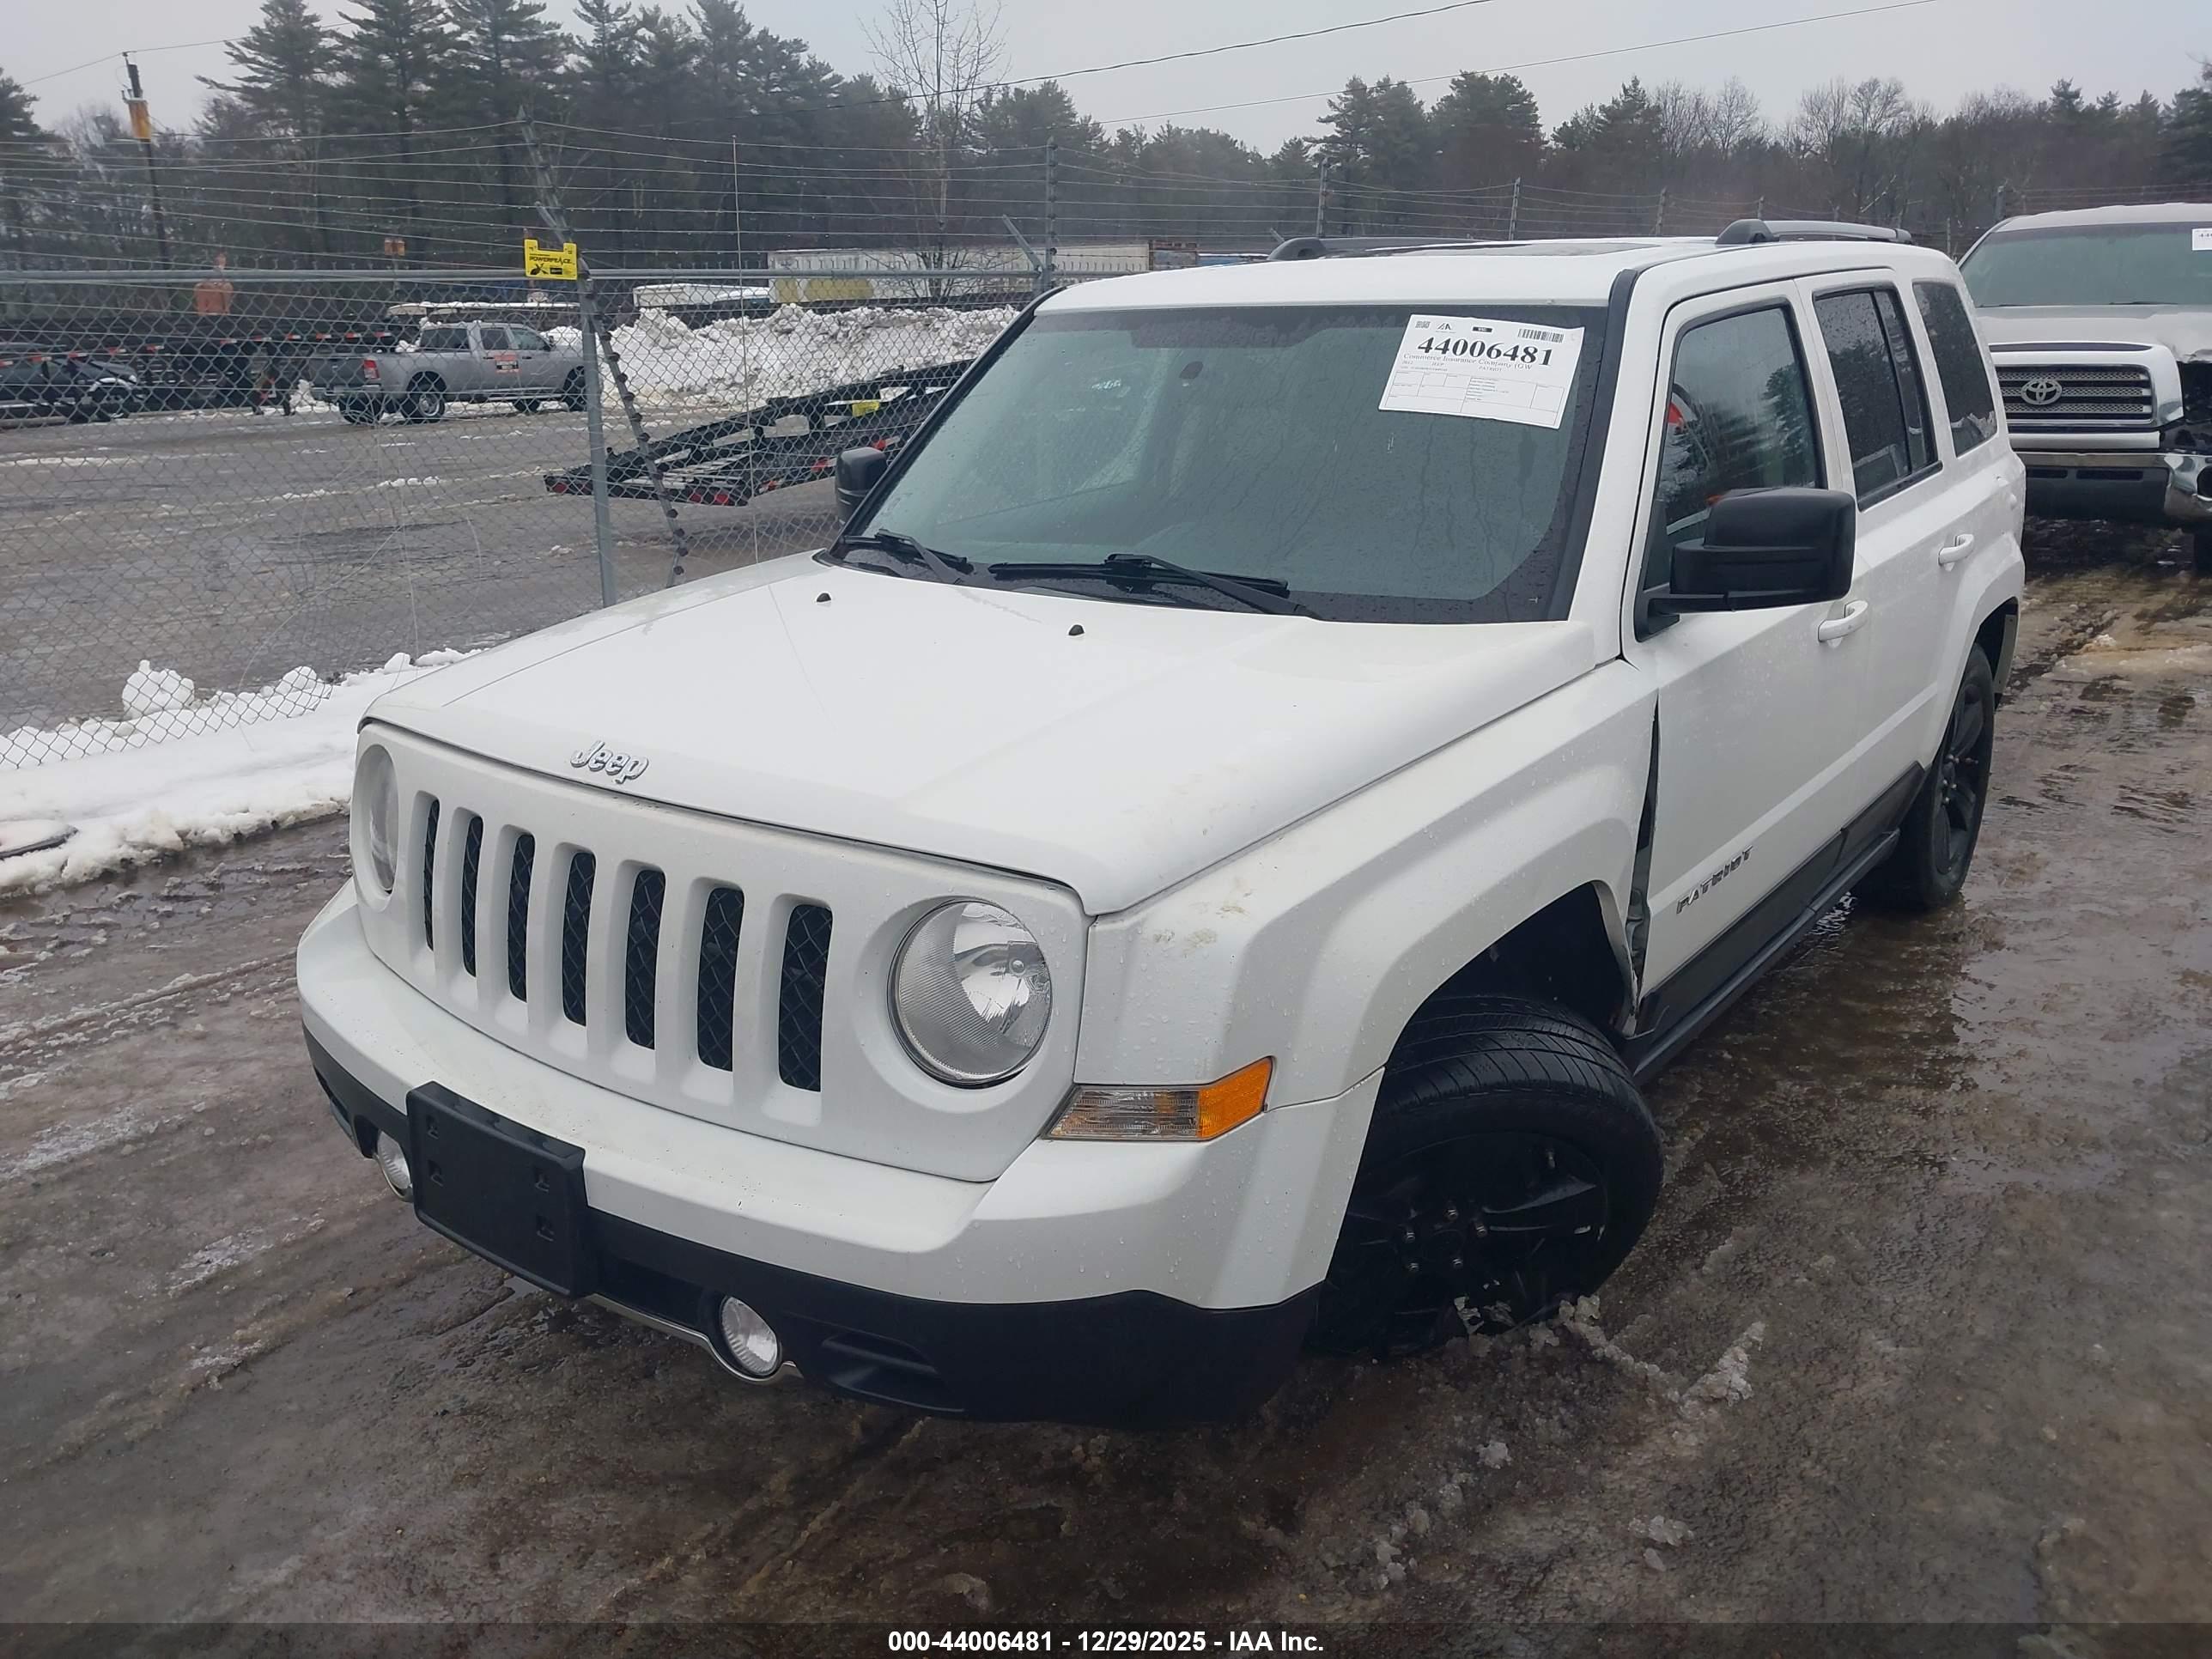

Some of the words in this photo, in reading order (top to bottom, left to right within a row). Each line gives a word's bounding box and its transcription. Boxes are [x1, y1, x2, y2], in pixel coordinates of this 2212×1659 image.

[1403, 353, 1442, 362] Commerce
[1443, 356, 1477, 364] Insurance
[1478, 358, 1511, 368] Company
[1418, 337, 1553, 367] 44006481
[570, 740, 649, 785] Jeep
[1676, 845, 1753, 915] PATRIOT
